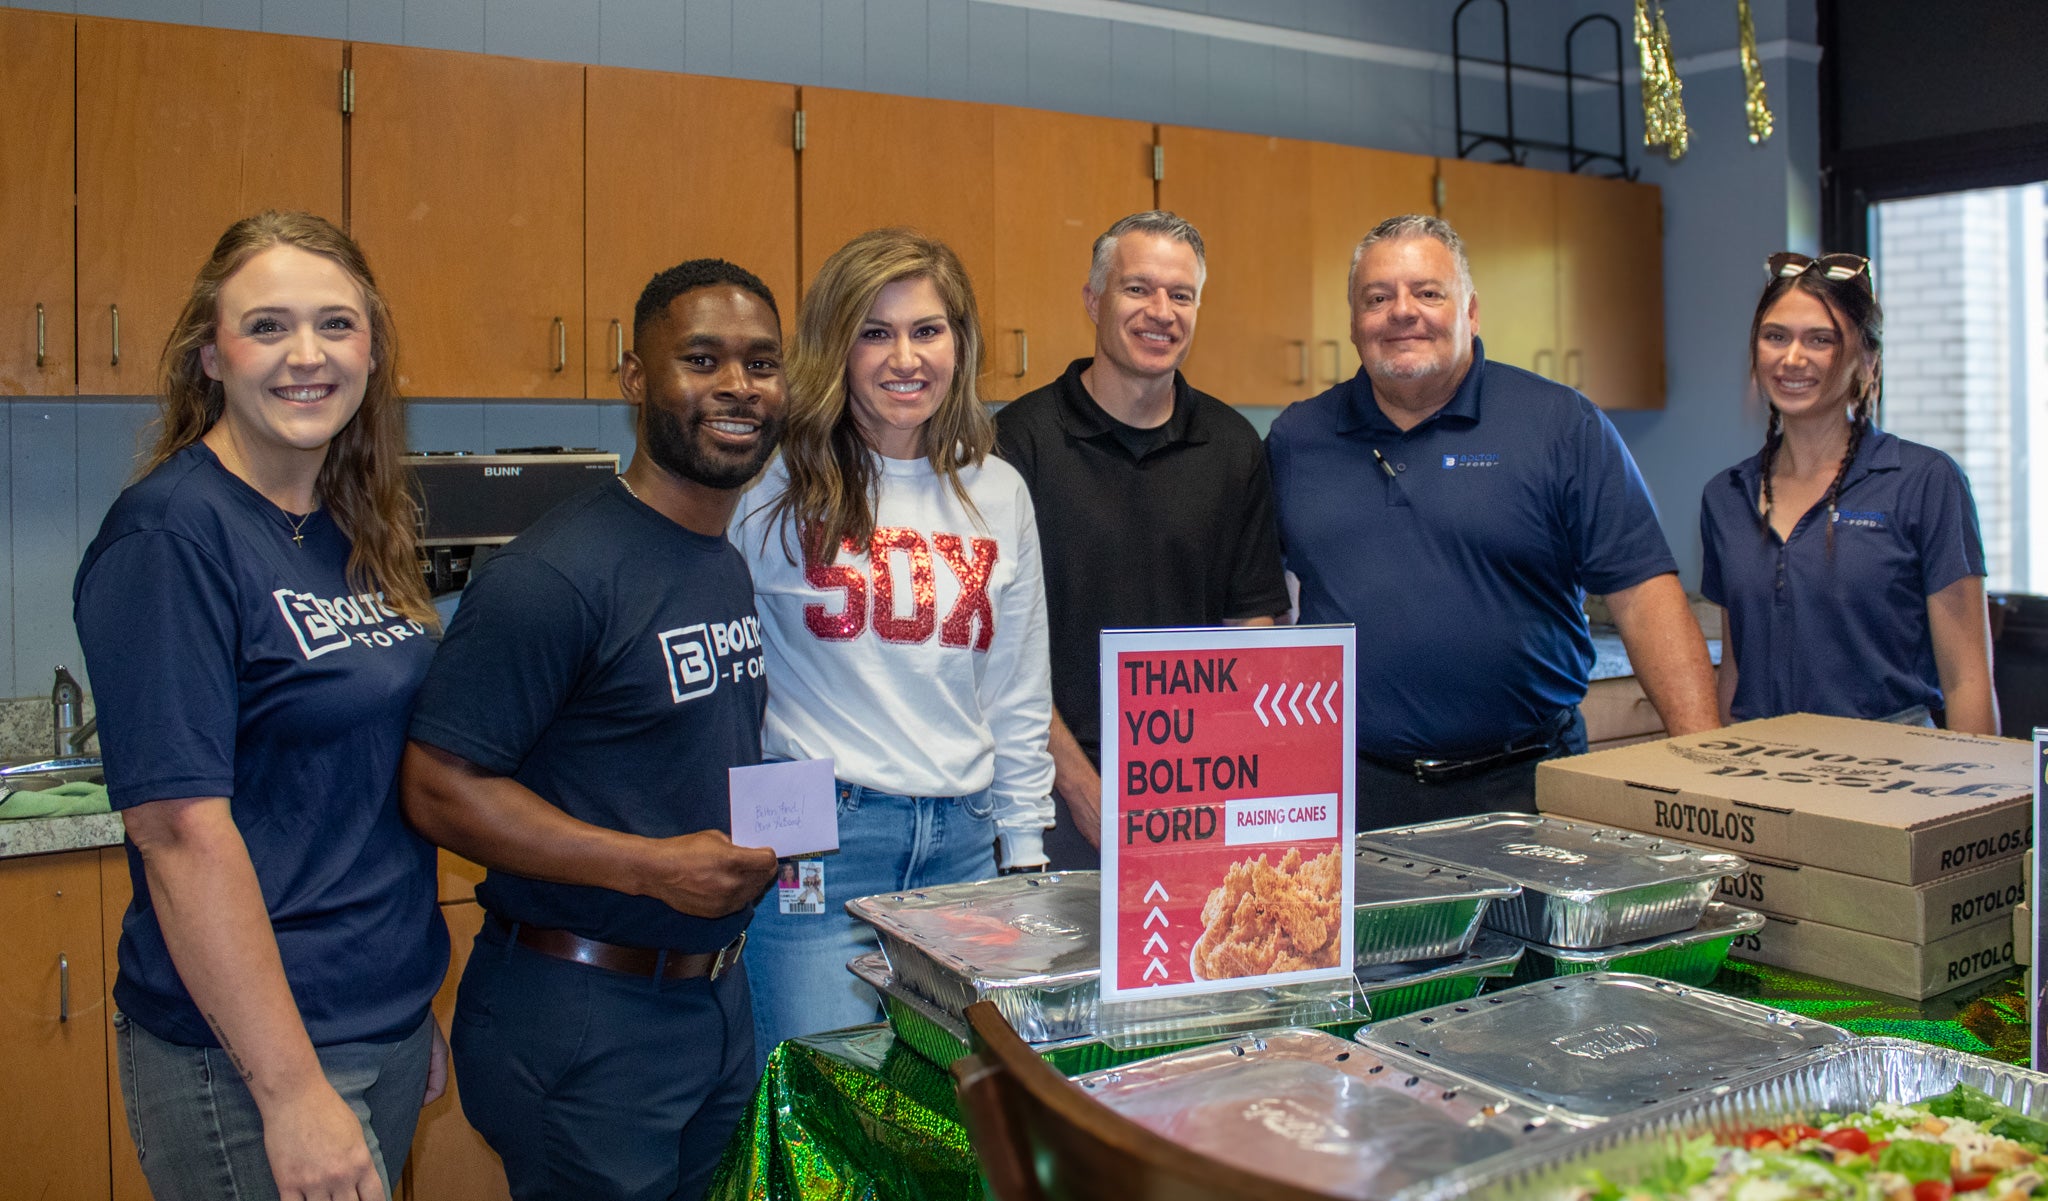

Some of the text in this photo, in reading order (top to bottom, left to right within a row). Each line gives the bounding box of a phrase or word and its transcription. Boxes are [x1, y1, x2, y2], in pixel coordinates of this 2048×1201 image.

[484, 466, 520, 477] BUNN
[801, 524, 1000, 653] SOX
[709, 615, 762, 657] BOLT
[1124, 657, 1239, 696] THANK
[1124, 708, 1195, 746] YOU
[1126, 754, 1259, 796] BOLTON
[1126, 806, 1218, 845] FORD
[1237, 805, 1327, 827] RAISING CANES
[1654, 800, 1756, 844] ROTOLO'S
[1940, 825, 2033, 871] ROTOLOS.C
